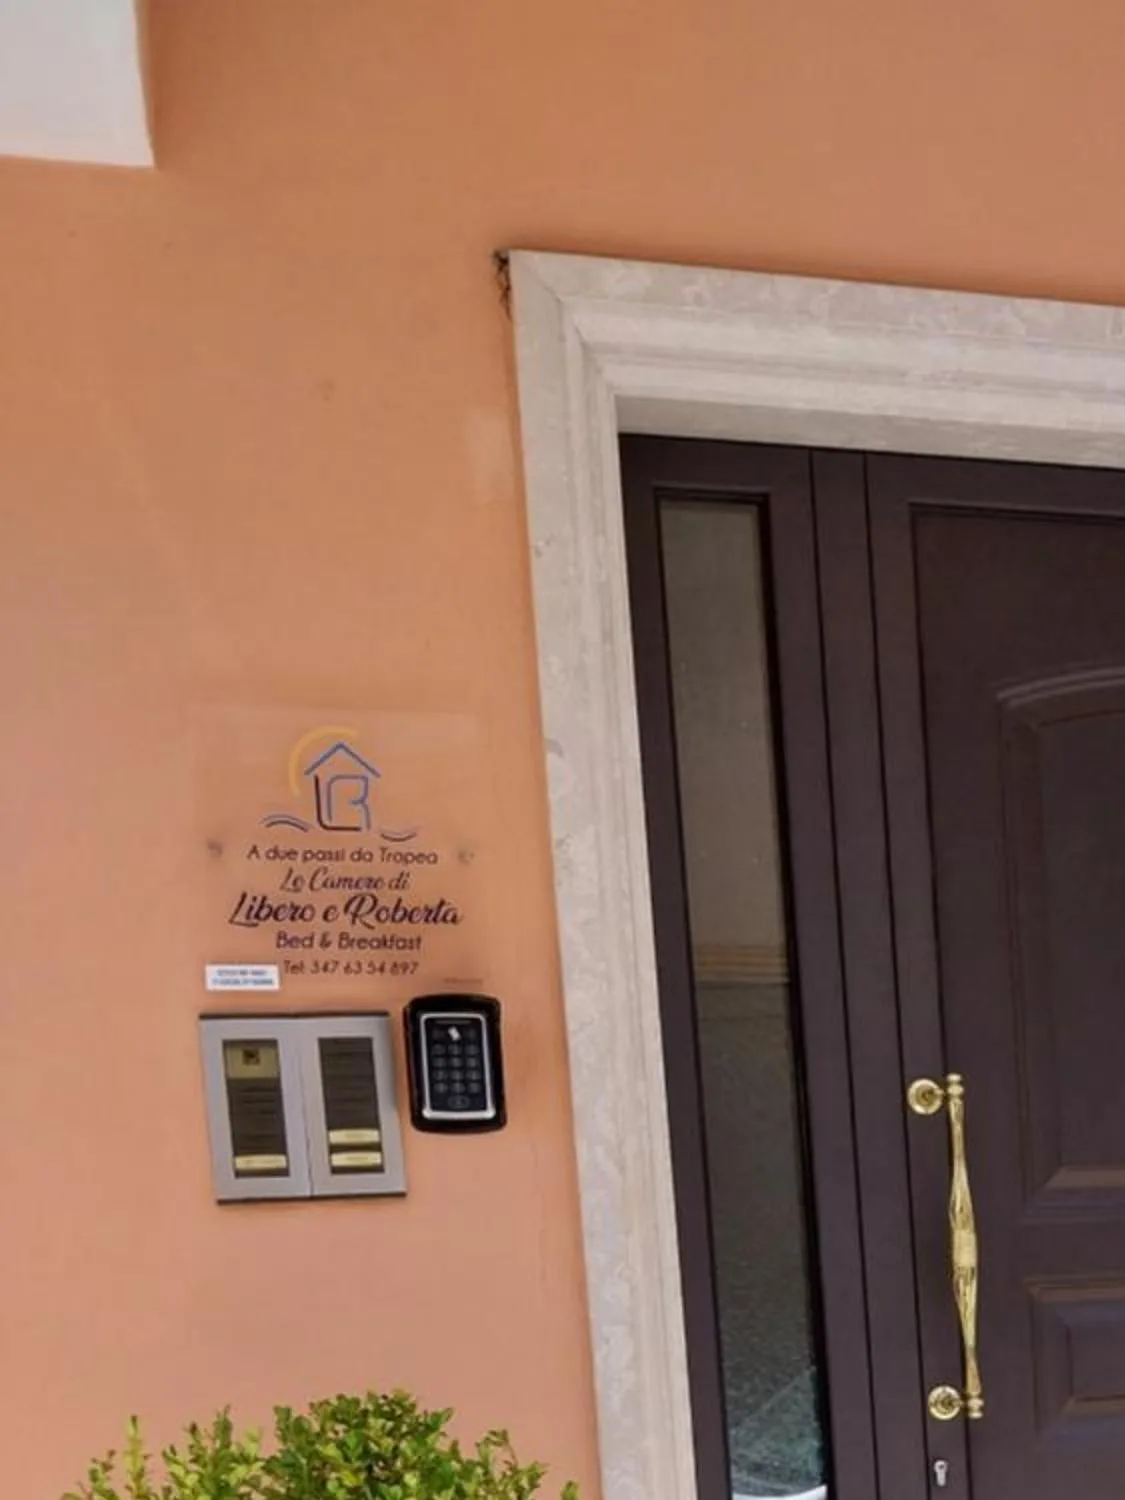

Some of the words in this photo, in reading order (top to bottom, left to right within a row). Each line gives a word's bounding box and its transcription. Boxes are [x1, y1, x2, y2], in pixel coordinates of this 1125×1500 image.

[246, 845, 261, 860] A
[265, 845, 298, 861] due
[302, 848, 345, 863] passi
[379, 847, 438, 865] Tropea
[388, 871, 411, 891] di
[228, 892, 316, 928] Libero
[322, 904, 339, 923] e
[343, 893, 462, 930] Roberta
[276, 930, 314, 949] Bed
[319, 931, 332, 950] &
[338, 931, 421, 950] Breakfast
